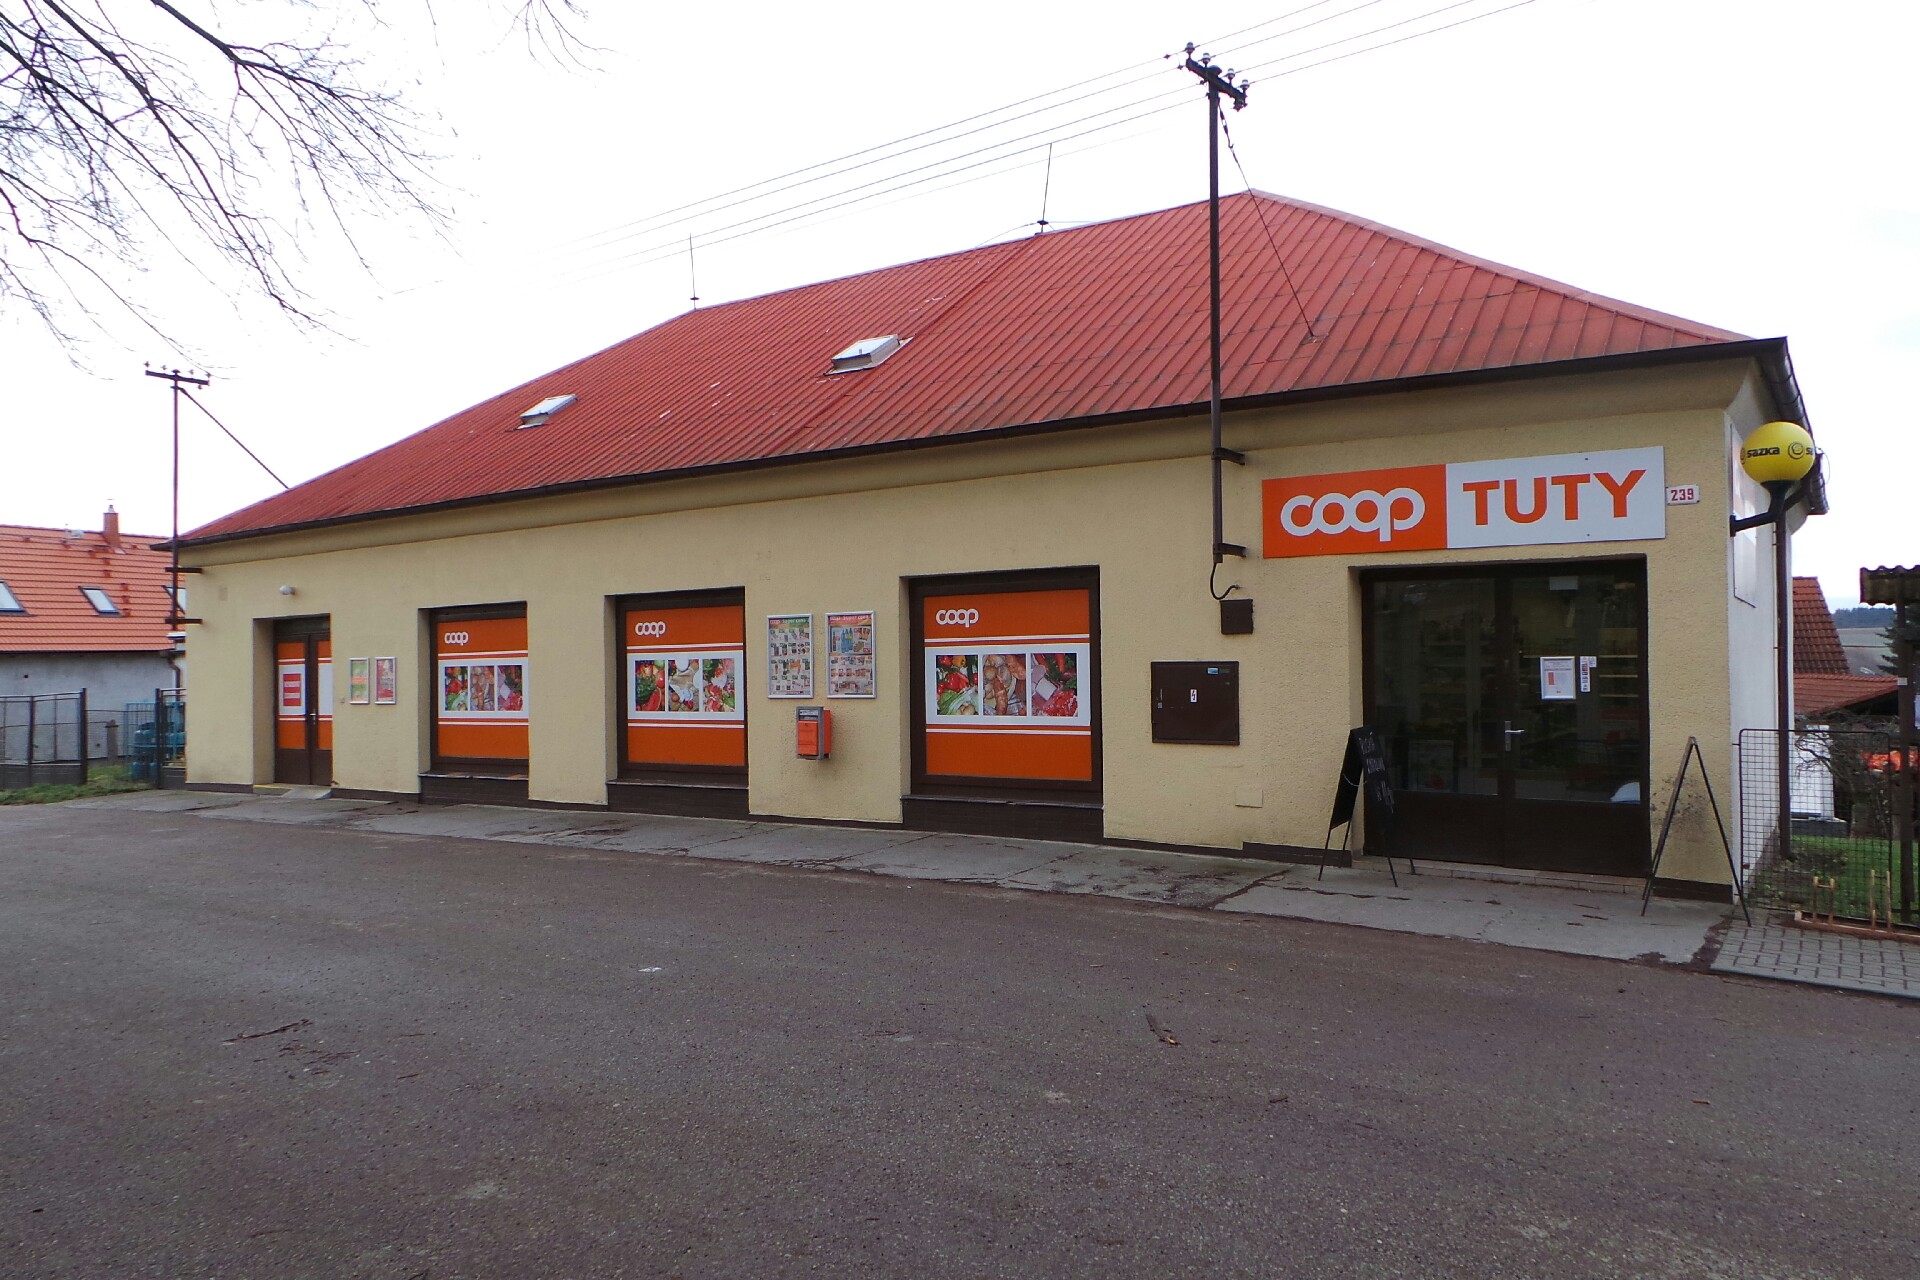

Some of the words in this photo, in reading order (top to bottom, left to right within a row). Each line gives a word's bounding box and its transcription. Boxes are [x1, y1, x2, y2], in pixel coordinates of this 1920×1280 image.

[1671, 488, 1694, 501] 239
[1280, 487, 1425, 542] coop
[1463, 469, 1646, 526] TUTY
[935, 608, 979, 628] coop
[635, 621, 666, 638] coop
[444, 631, 469, 646] coop
